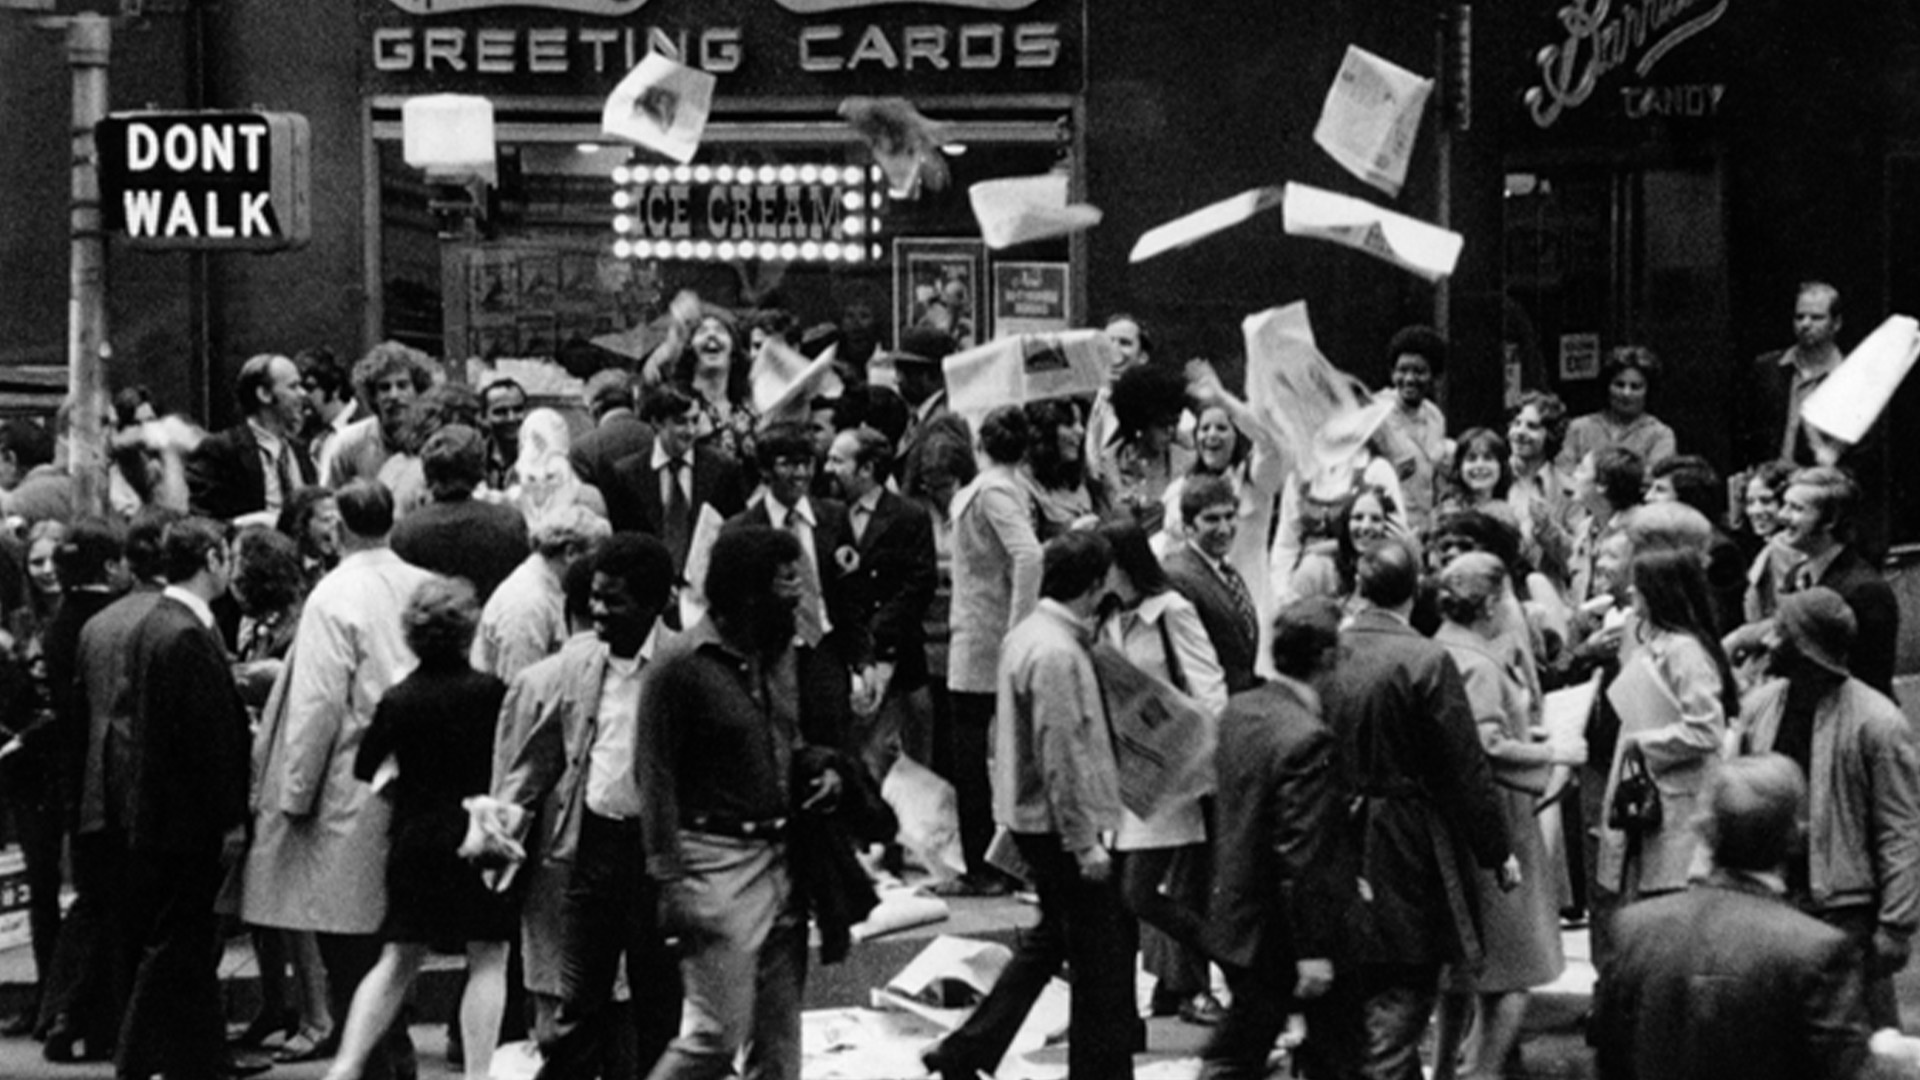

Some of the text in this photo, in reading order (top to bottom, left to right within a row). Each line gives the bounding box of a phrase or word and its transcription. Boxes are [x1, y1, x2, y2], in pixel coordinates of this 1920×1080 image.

[373, 24, 1060, 72] GREETING CARDS
[127, 122, 267, 172] DONT
[123, 190, 272, 238] WALK
[631, 185, 844, 240] ICE CREAM
